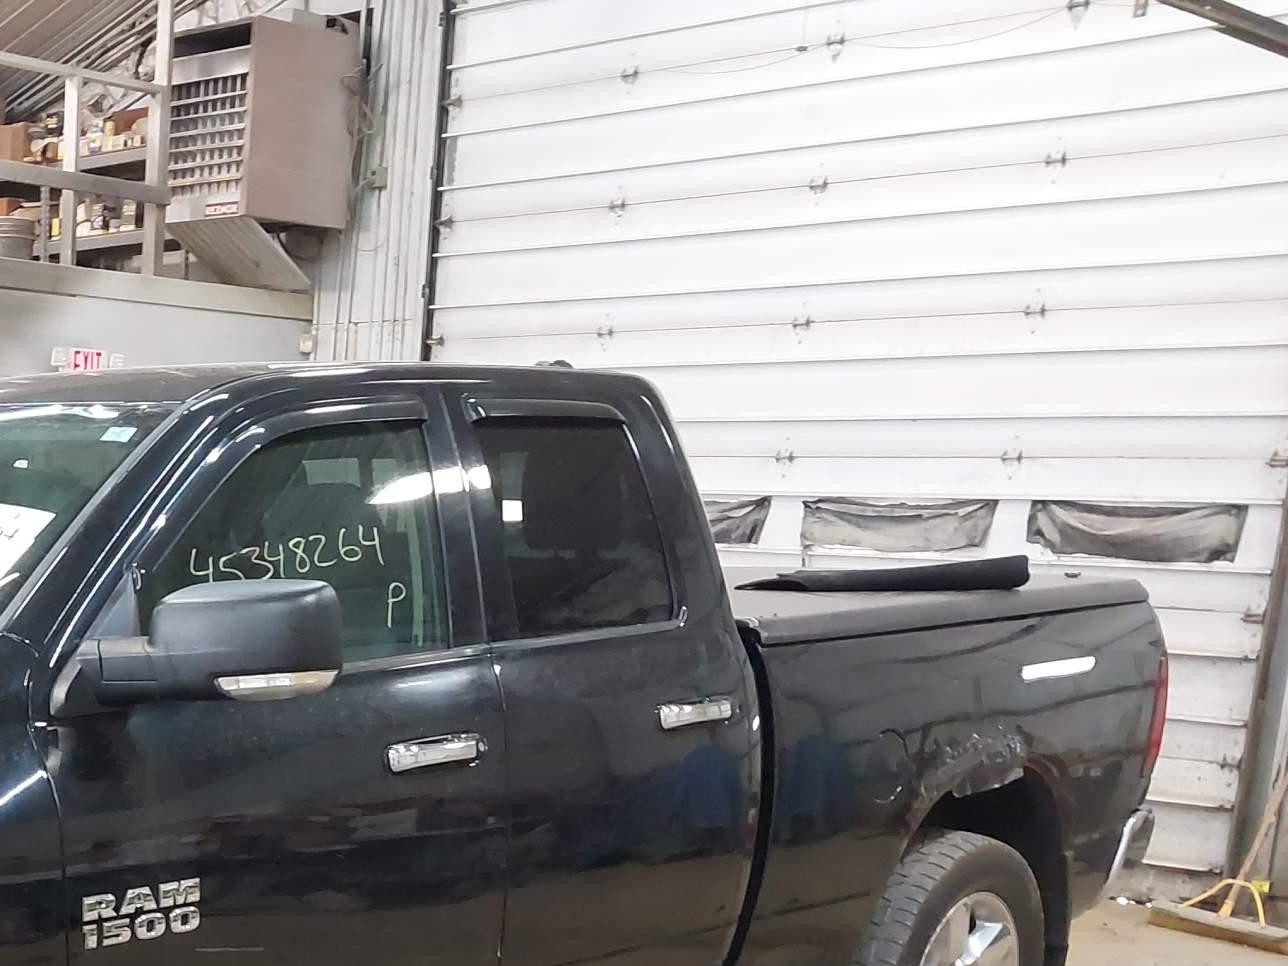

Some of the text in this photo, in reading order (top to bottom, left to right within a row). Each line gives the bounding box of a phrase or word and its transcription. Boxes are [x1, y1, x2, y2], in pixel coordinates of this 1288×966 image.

[73, 350, 102, 370] EXIT
[189, 524, 385, 581] 45348264
[82, 877, 201, 922] RAM
[82, 905, 201, 950] 1500
